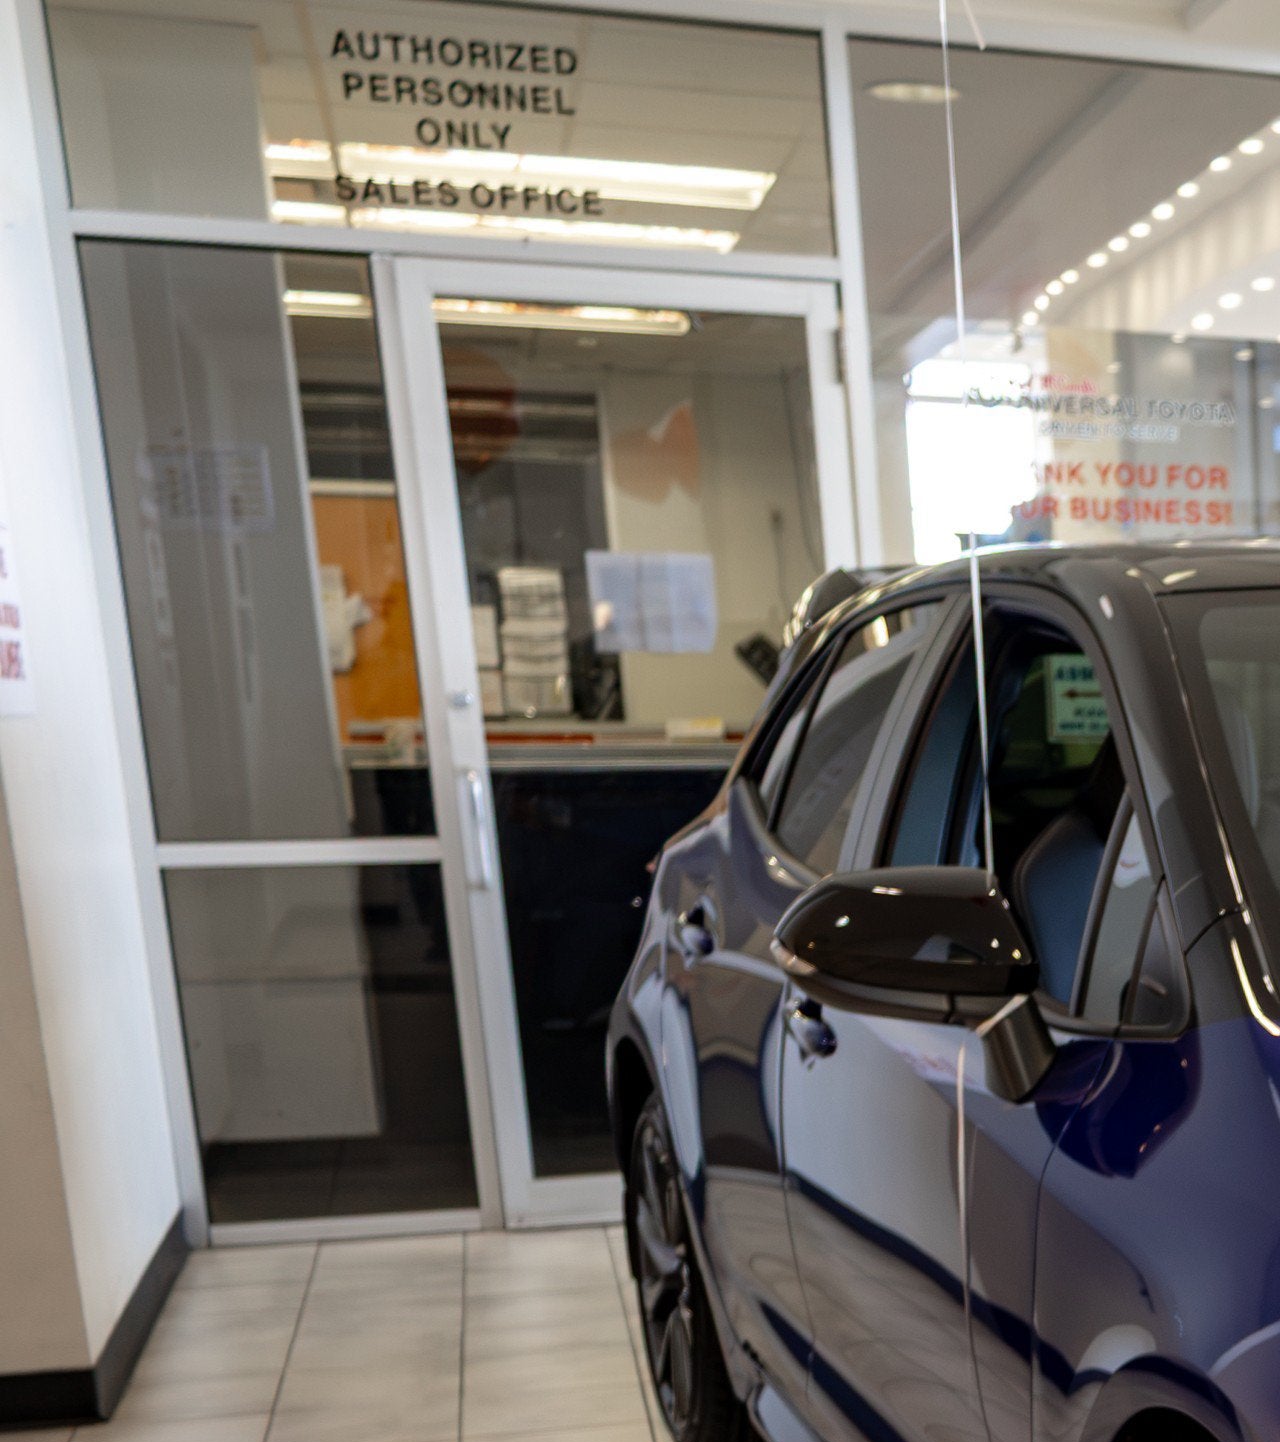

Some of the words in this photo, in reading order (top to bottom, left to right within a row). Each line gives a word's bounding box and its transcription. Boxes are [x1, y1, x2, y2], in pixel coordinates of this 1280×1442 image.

[330, 28, 578, 75] AUTHORIZED
[341, 71, 576, 116] PERSONNEL
[415, 116, 512, 149] ONLY
[334, 173, 460, 208] SALES
[469, 182, 604, 216] OFFICE
[1147, 400, 1235, 424] TOYOTA
[1092, 462, 1159, 489] YOU
[1165, 464, 1230, 490] FOR
[1068, 496, 1235, 526] BUSINESS!
